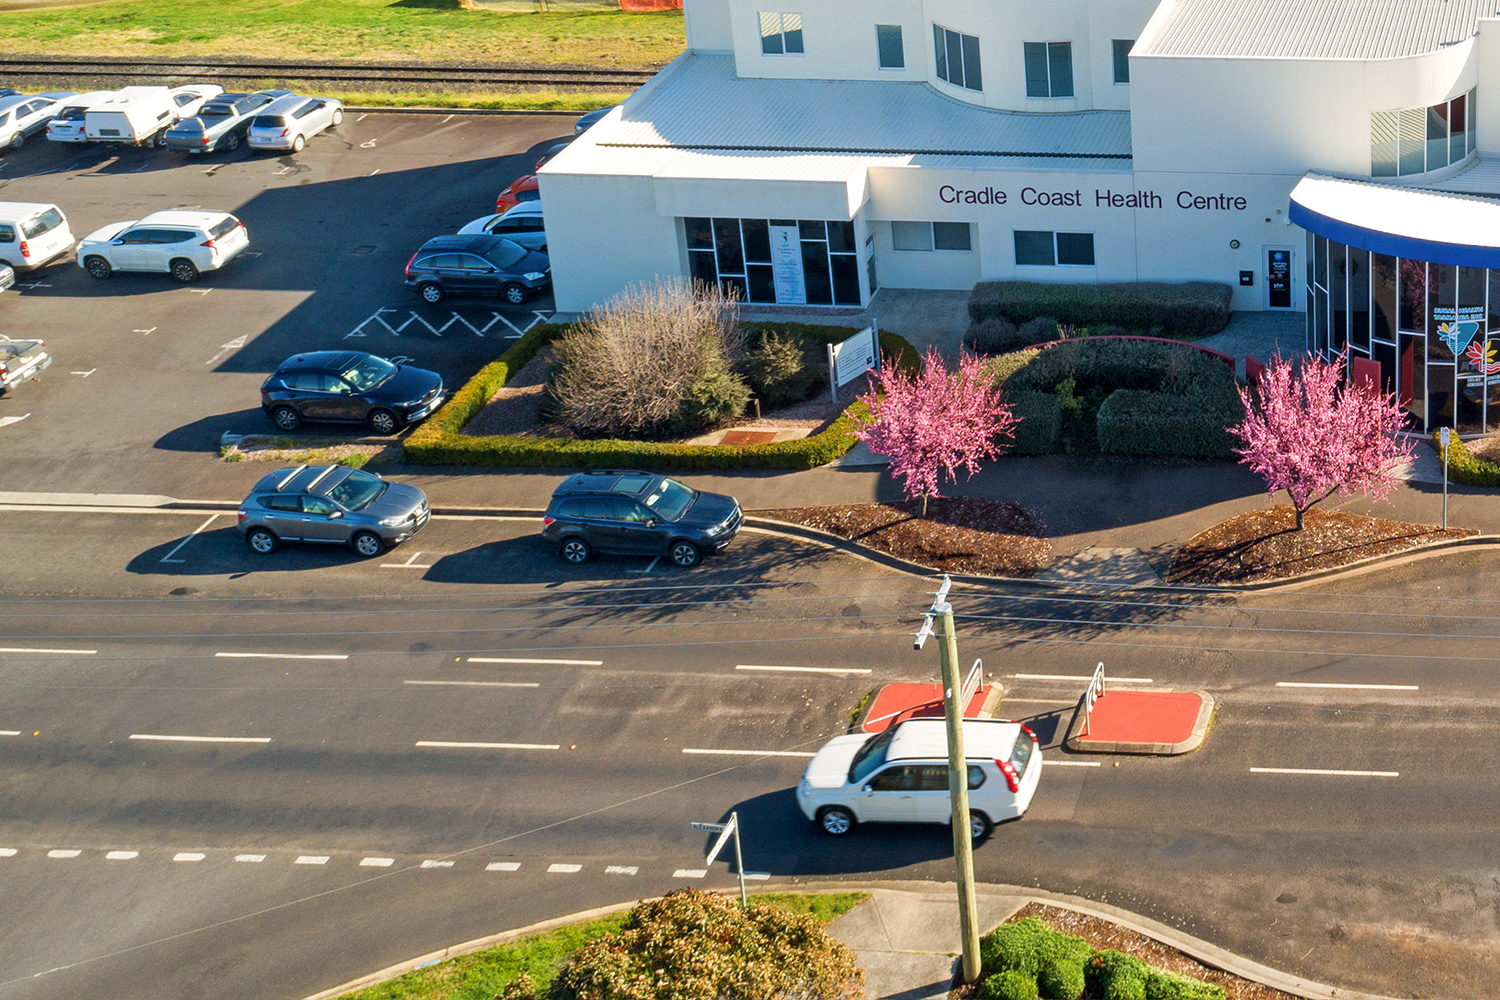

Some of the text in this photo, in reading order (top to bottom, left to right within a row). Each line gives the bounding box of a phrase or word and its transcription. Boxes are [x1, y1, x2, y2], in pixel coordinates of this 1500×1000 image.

[940, 186, 1246, 210] Cradle Coast Health Centre
